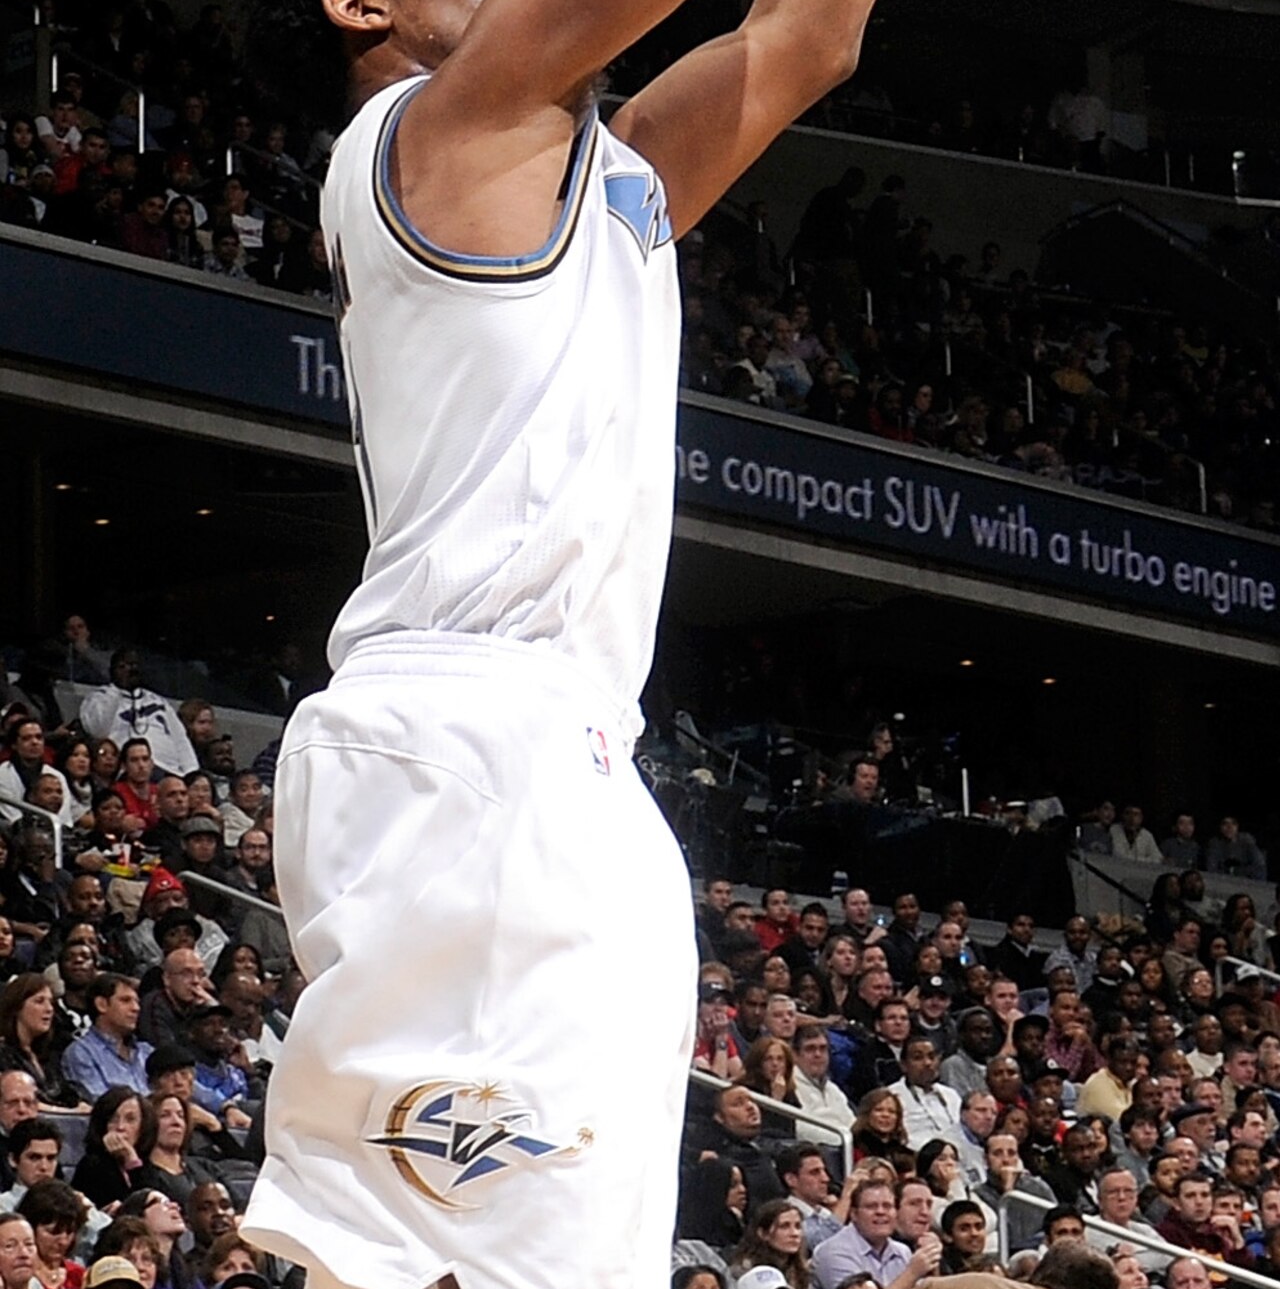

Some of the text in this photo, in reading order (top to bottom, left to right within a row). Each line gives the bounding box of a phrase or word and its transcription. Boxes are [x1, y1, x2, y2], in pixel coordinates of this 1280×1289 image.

[290, 335, 340, 401] Th
[721, 456, 875, 522] compact
[884, 475, 961, 540] SUV
[969, 504, 1039, 559] with
[1048, 532, 1071, 565] a
[1080, 530, 1166, 587] turbo
[1174, 558, 1276, 614] engine
